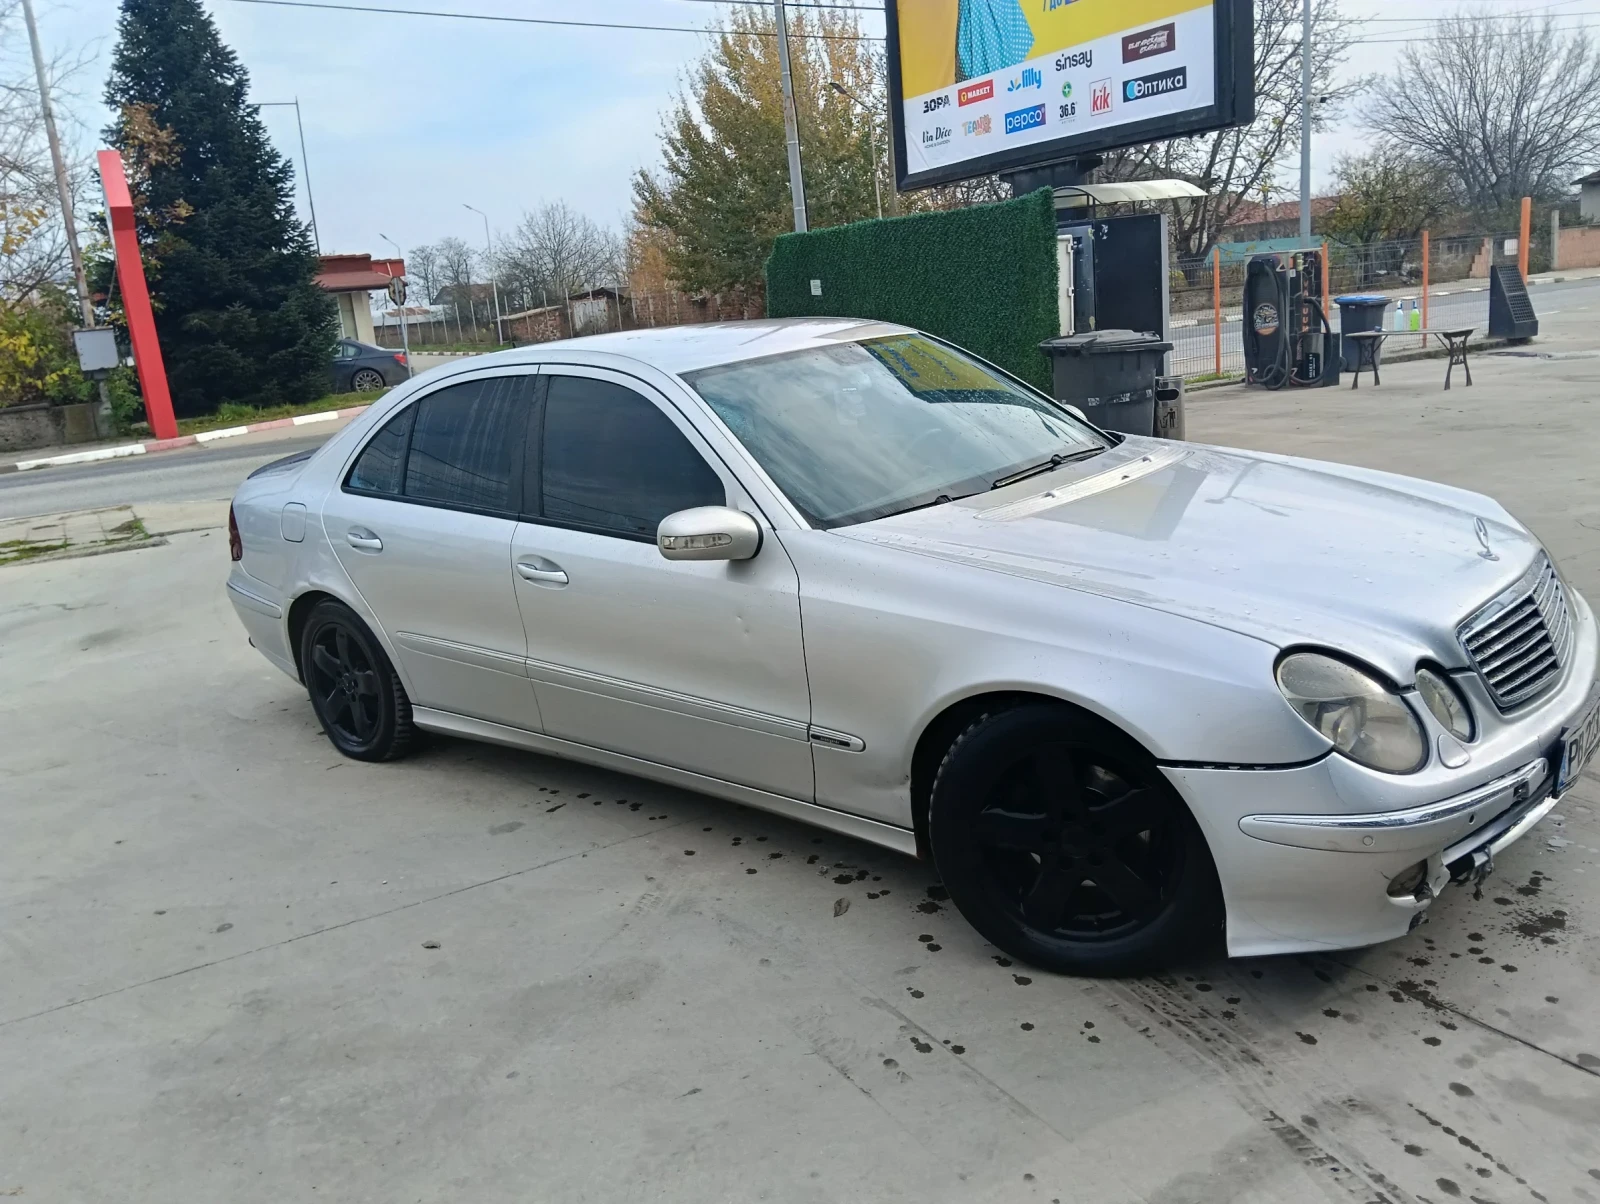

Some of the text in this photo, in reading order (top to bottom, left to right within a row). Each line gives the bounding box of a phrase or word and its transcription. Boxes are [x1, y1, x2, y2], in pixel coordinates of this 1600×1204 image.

[1055, 50, 1092, 71] sinsay
[1022, 68, 1042, 89] lilly
[967, 86, 991, 99] MARKET
